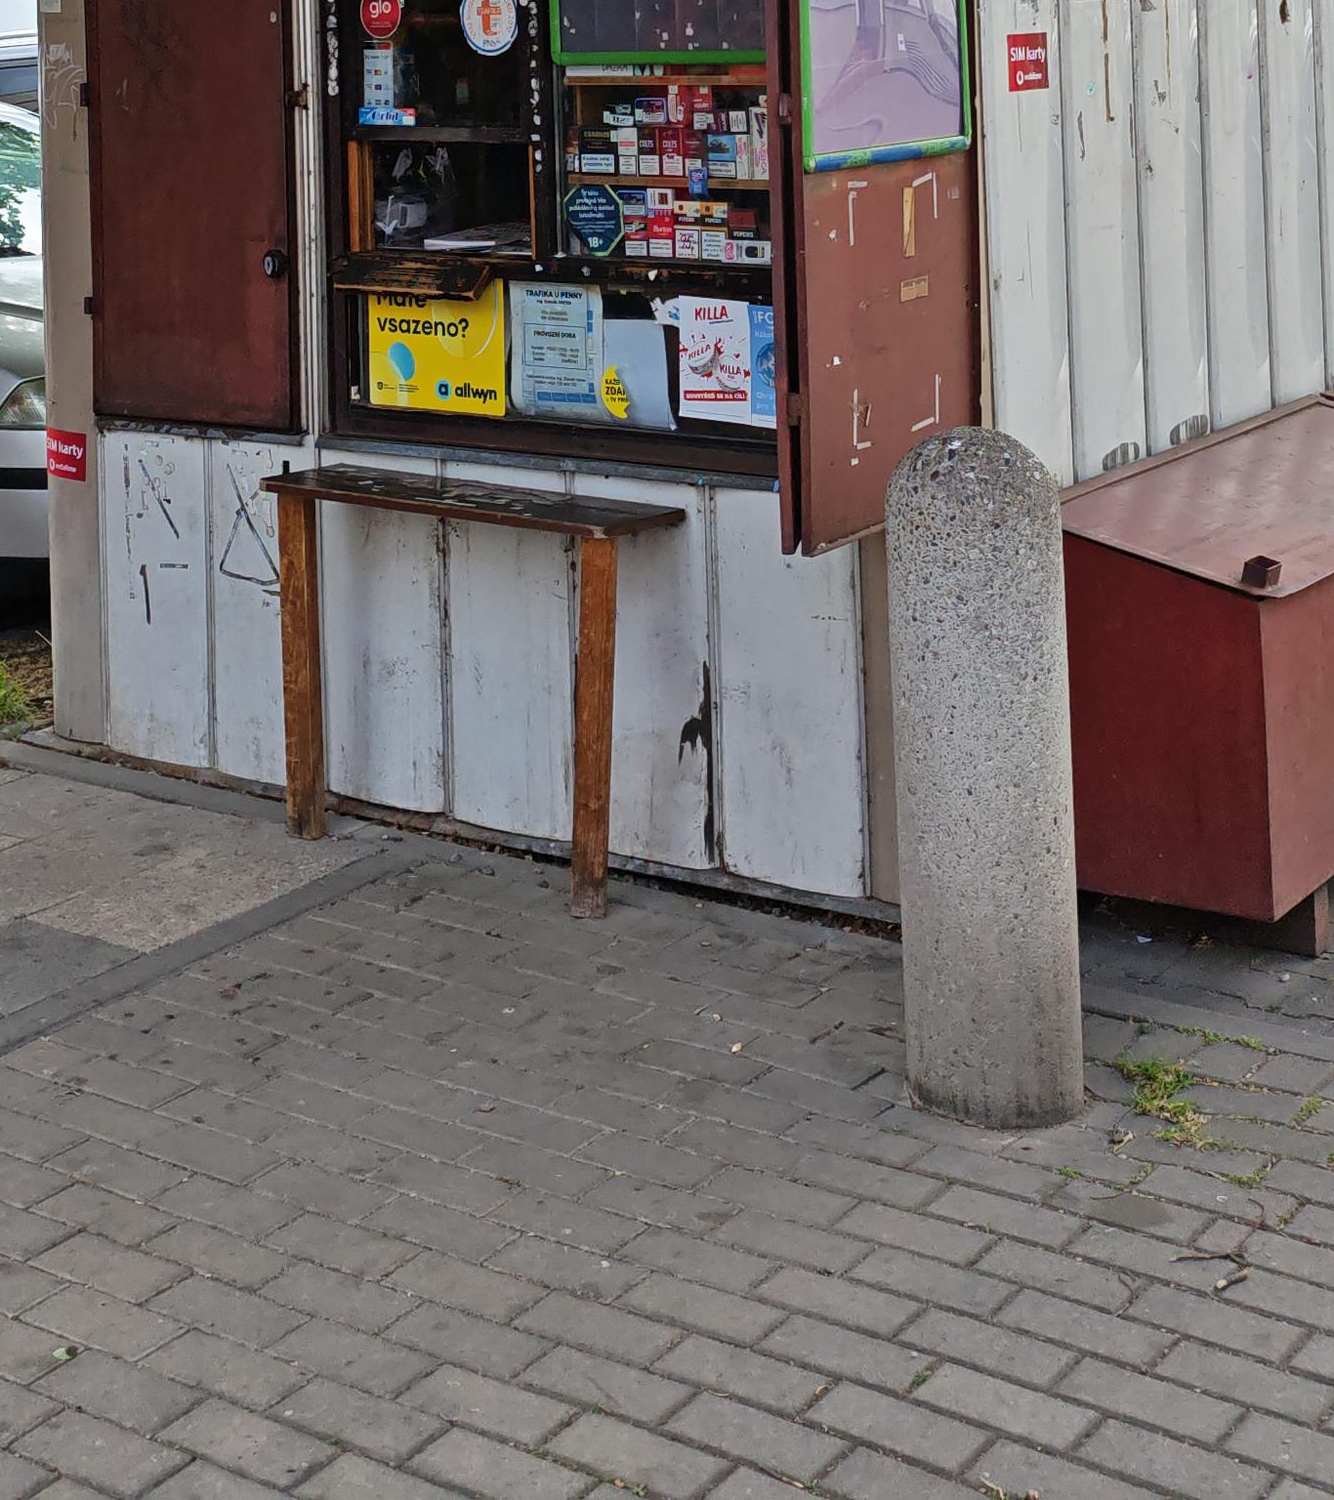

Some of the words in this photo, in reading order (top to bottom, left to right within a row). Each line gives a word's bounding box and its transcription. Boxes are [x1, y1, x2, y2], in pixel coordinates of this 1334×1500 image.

[1010, 46, 1026, 62] SIM
[1026, 46, 1045, 63] karty
[555, 291, 559, 299] U
[694, 305, 728, 321] KILLA
[376, 317, 470, 339] vsazeno?
[687, 344, 712, 360] KILLA
[719, 363, 742, 375] KILLA
[454, 382, 498, 404] allwyn
[58, 440, 84, 460] karty
